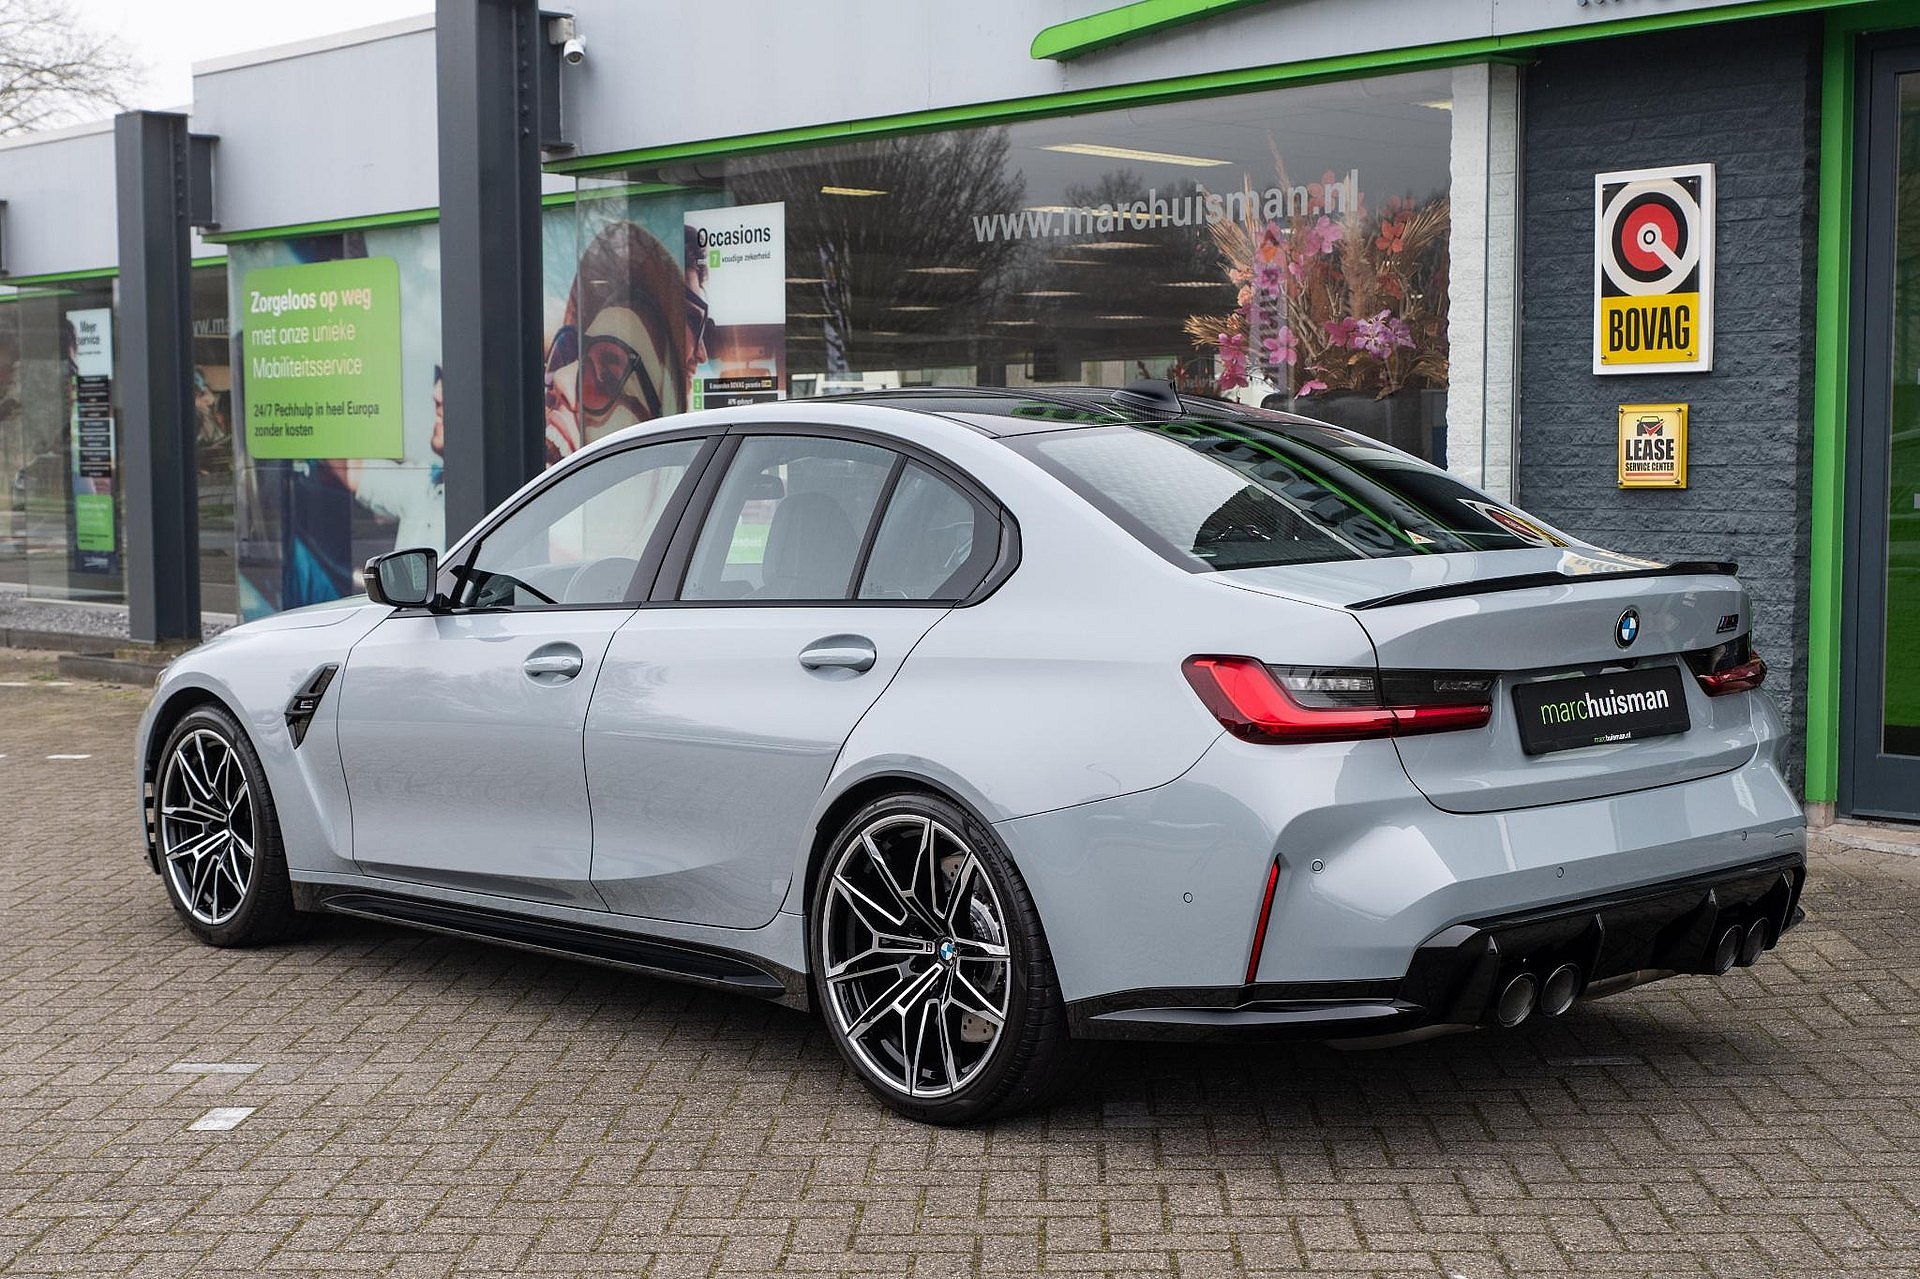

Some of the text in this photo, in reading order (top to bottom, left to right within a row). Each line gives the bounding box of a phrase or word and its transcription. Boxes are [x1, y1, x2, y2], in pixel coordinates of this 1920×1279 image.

[972, 169, 1359, 242] www.marchuisman.nl
[697, 224, 771, 248] Occasions
[250, 288, 372, 317] Zorgeloos op weg
[252, 320, 356, 346] met onze unieke
[1609, 305, 1690, 352] BOVAG
[252, 354, 363, 380] Mobiliteitsservice
[254, 400, 380, 418] 24/7 Pechhulp in heel Europa
[254, 422, 315, 437] zonder kosten
[1625, 438, 1675, 461] LEASE
[1625, 461, 1675, 472] SERVICE CENTER
[1540, 688, 1670, 725] marchuisman
